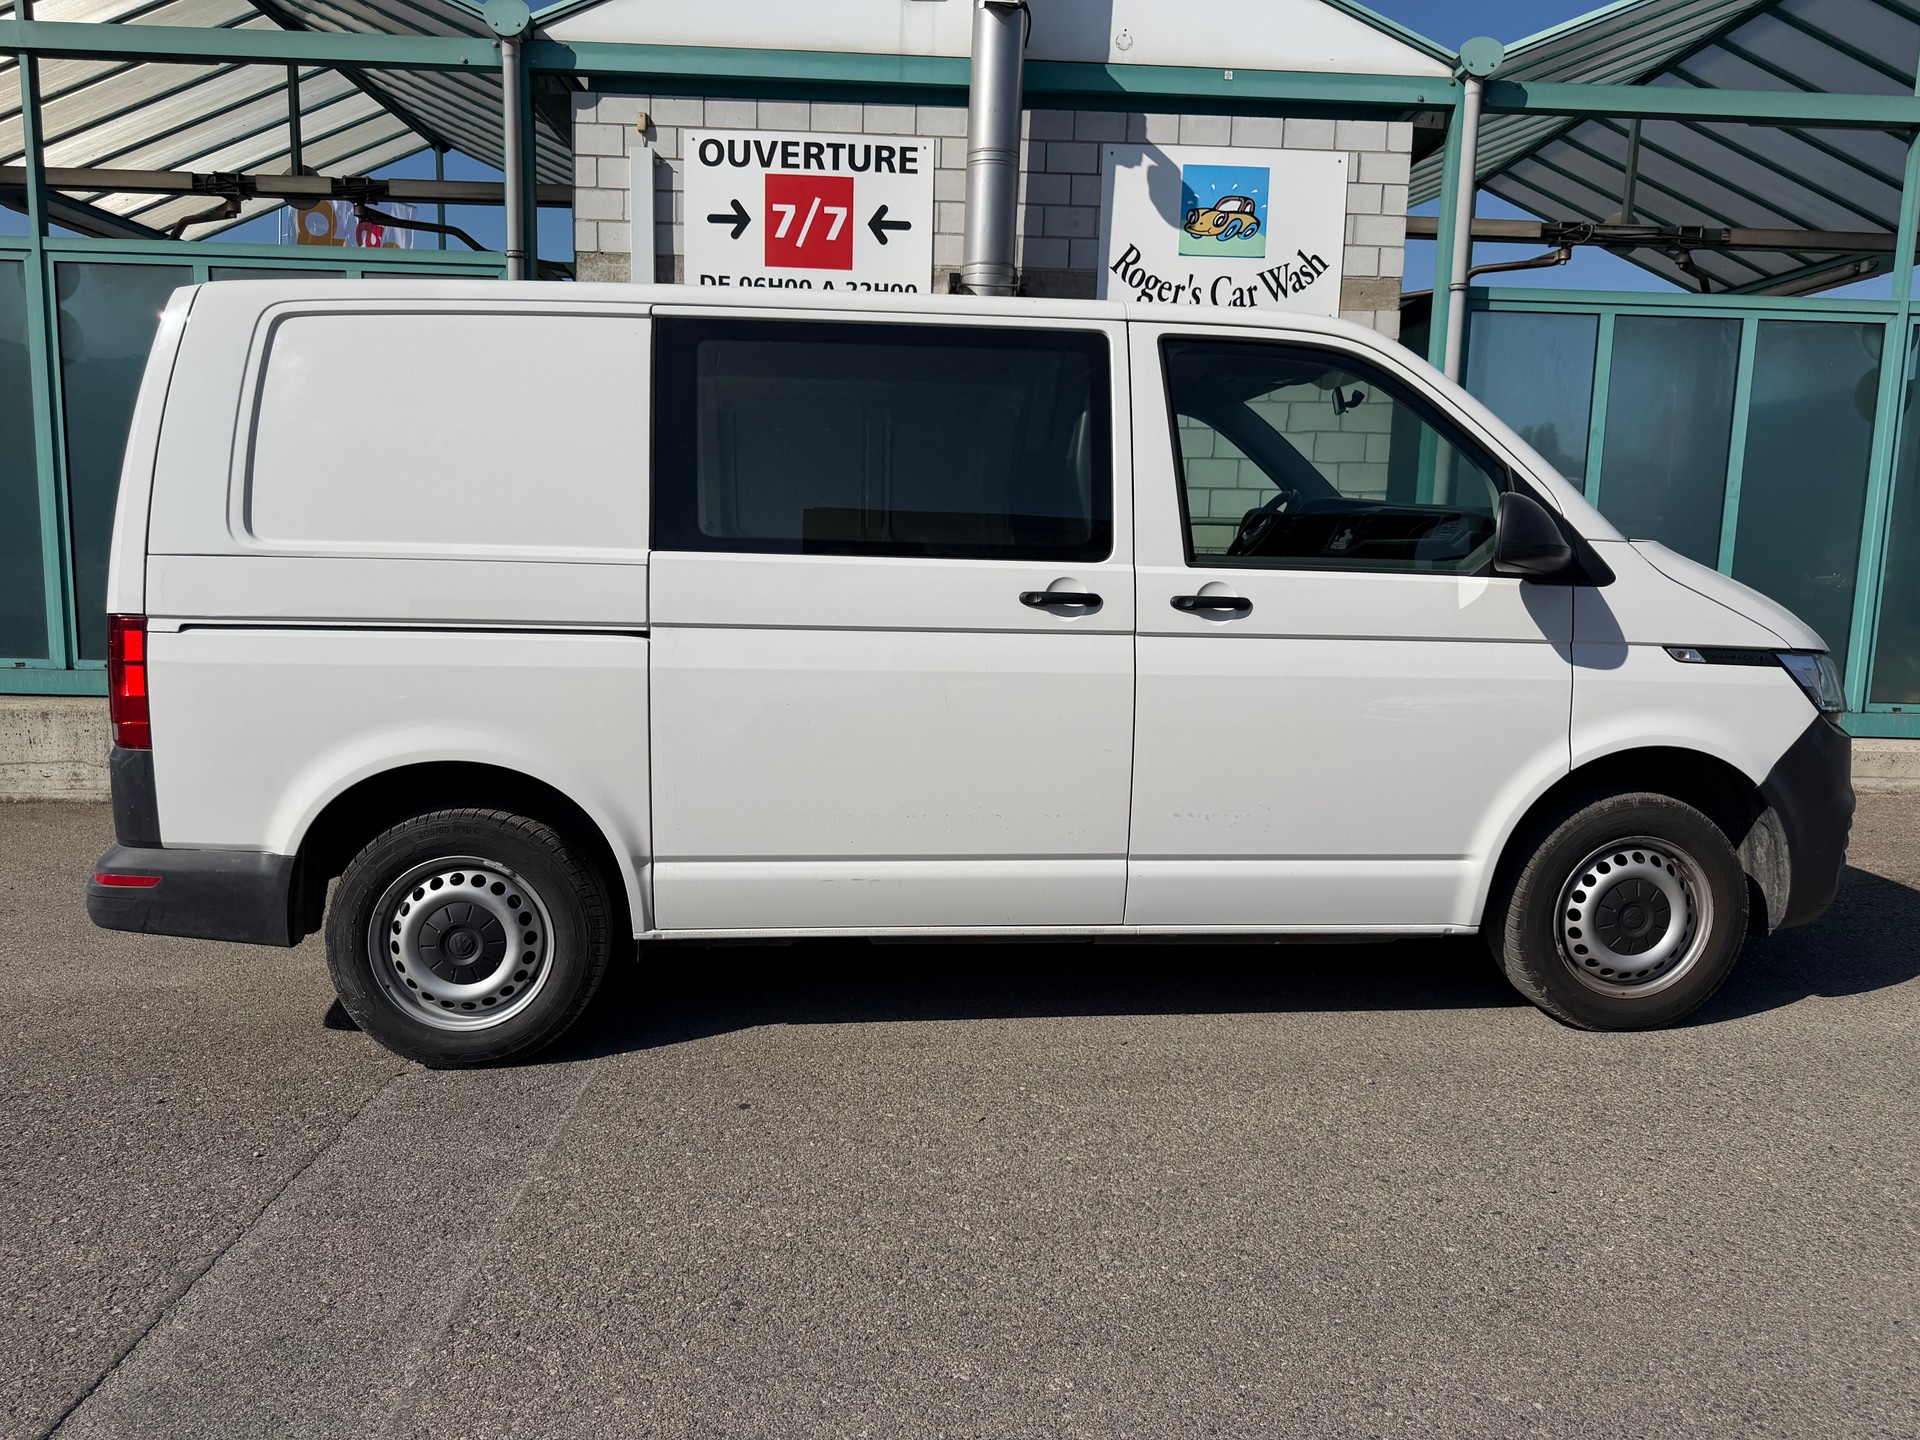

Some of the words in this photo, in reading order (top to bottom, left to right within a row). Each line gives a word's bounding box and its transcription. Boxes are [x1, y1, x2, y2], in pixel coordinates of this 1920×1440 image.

[698, 138, 919, 174] OUVERTURE
[771, 196, 848, 248] 7/7
[1109, 242, 1202, 304] Roger's
[1210, 275, 1258, 307] Car
[1256, 248, 1330, 302] Wash
